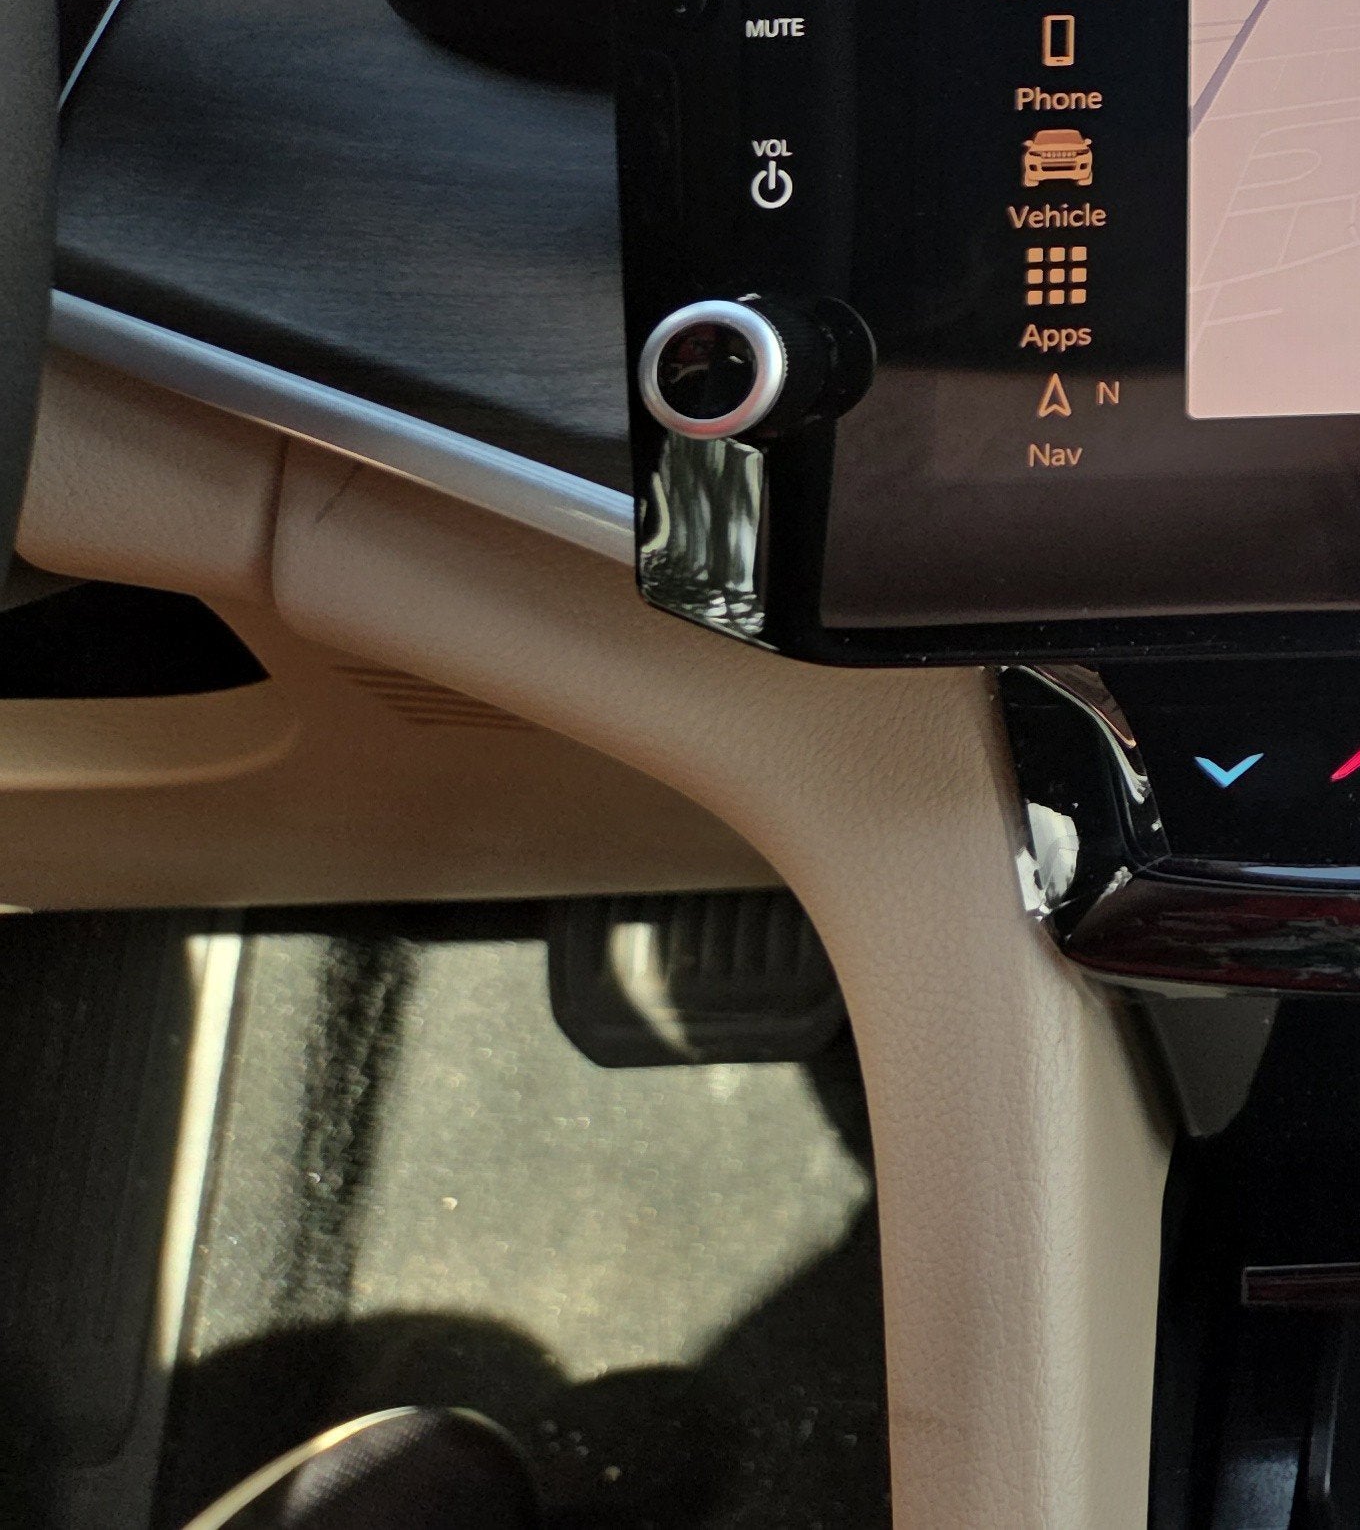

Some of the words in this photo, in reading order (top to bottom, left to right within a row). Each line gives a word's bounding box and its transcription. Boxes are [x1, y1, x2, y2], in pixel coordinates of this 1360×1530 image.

[746, 18, 805, 38] MUTE
[1015, 87, 1103, 110] Phone
[752, 140, 792, 157] VOL
[1009, 205, 1107, 228] Vehicle
[1020, 324, 1092, 350] Apps
[1098, 381, 1120, 405] N
[1028, 443, 1083, 467] Nav
